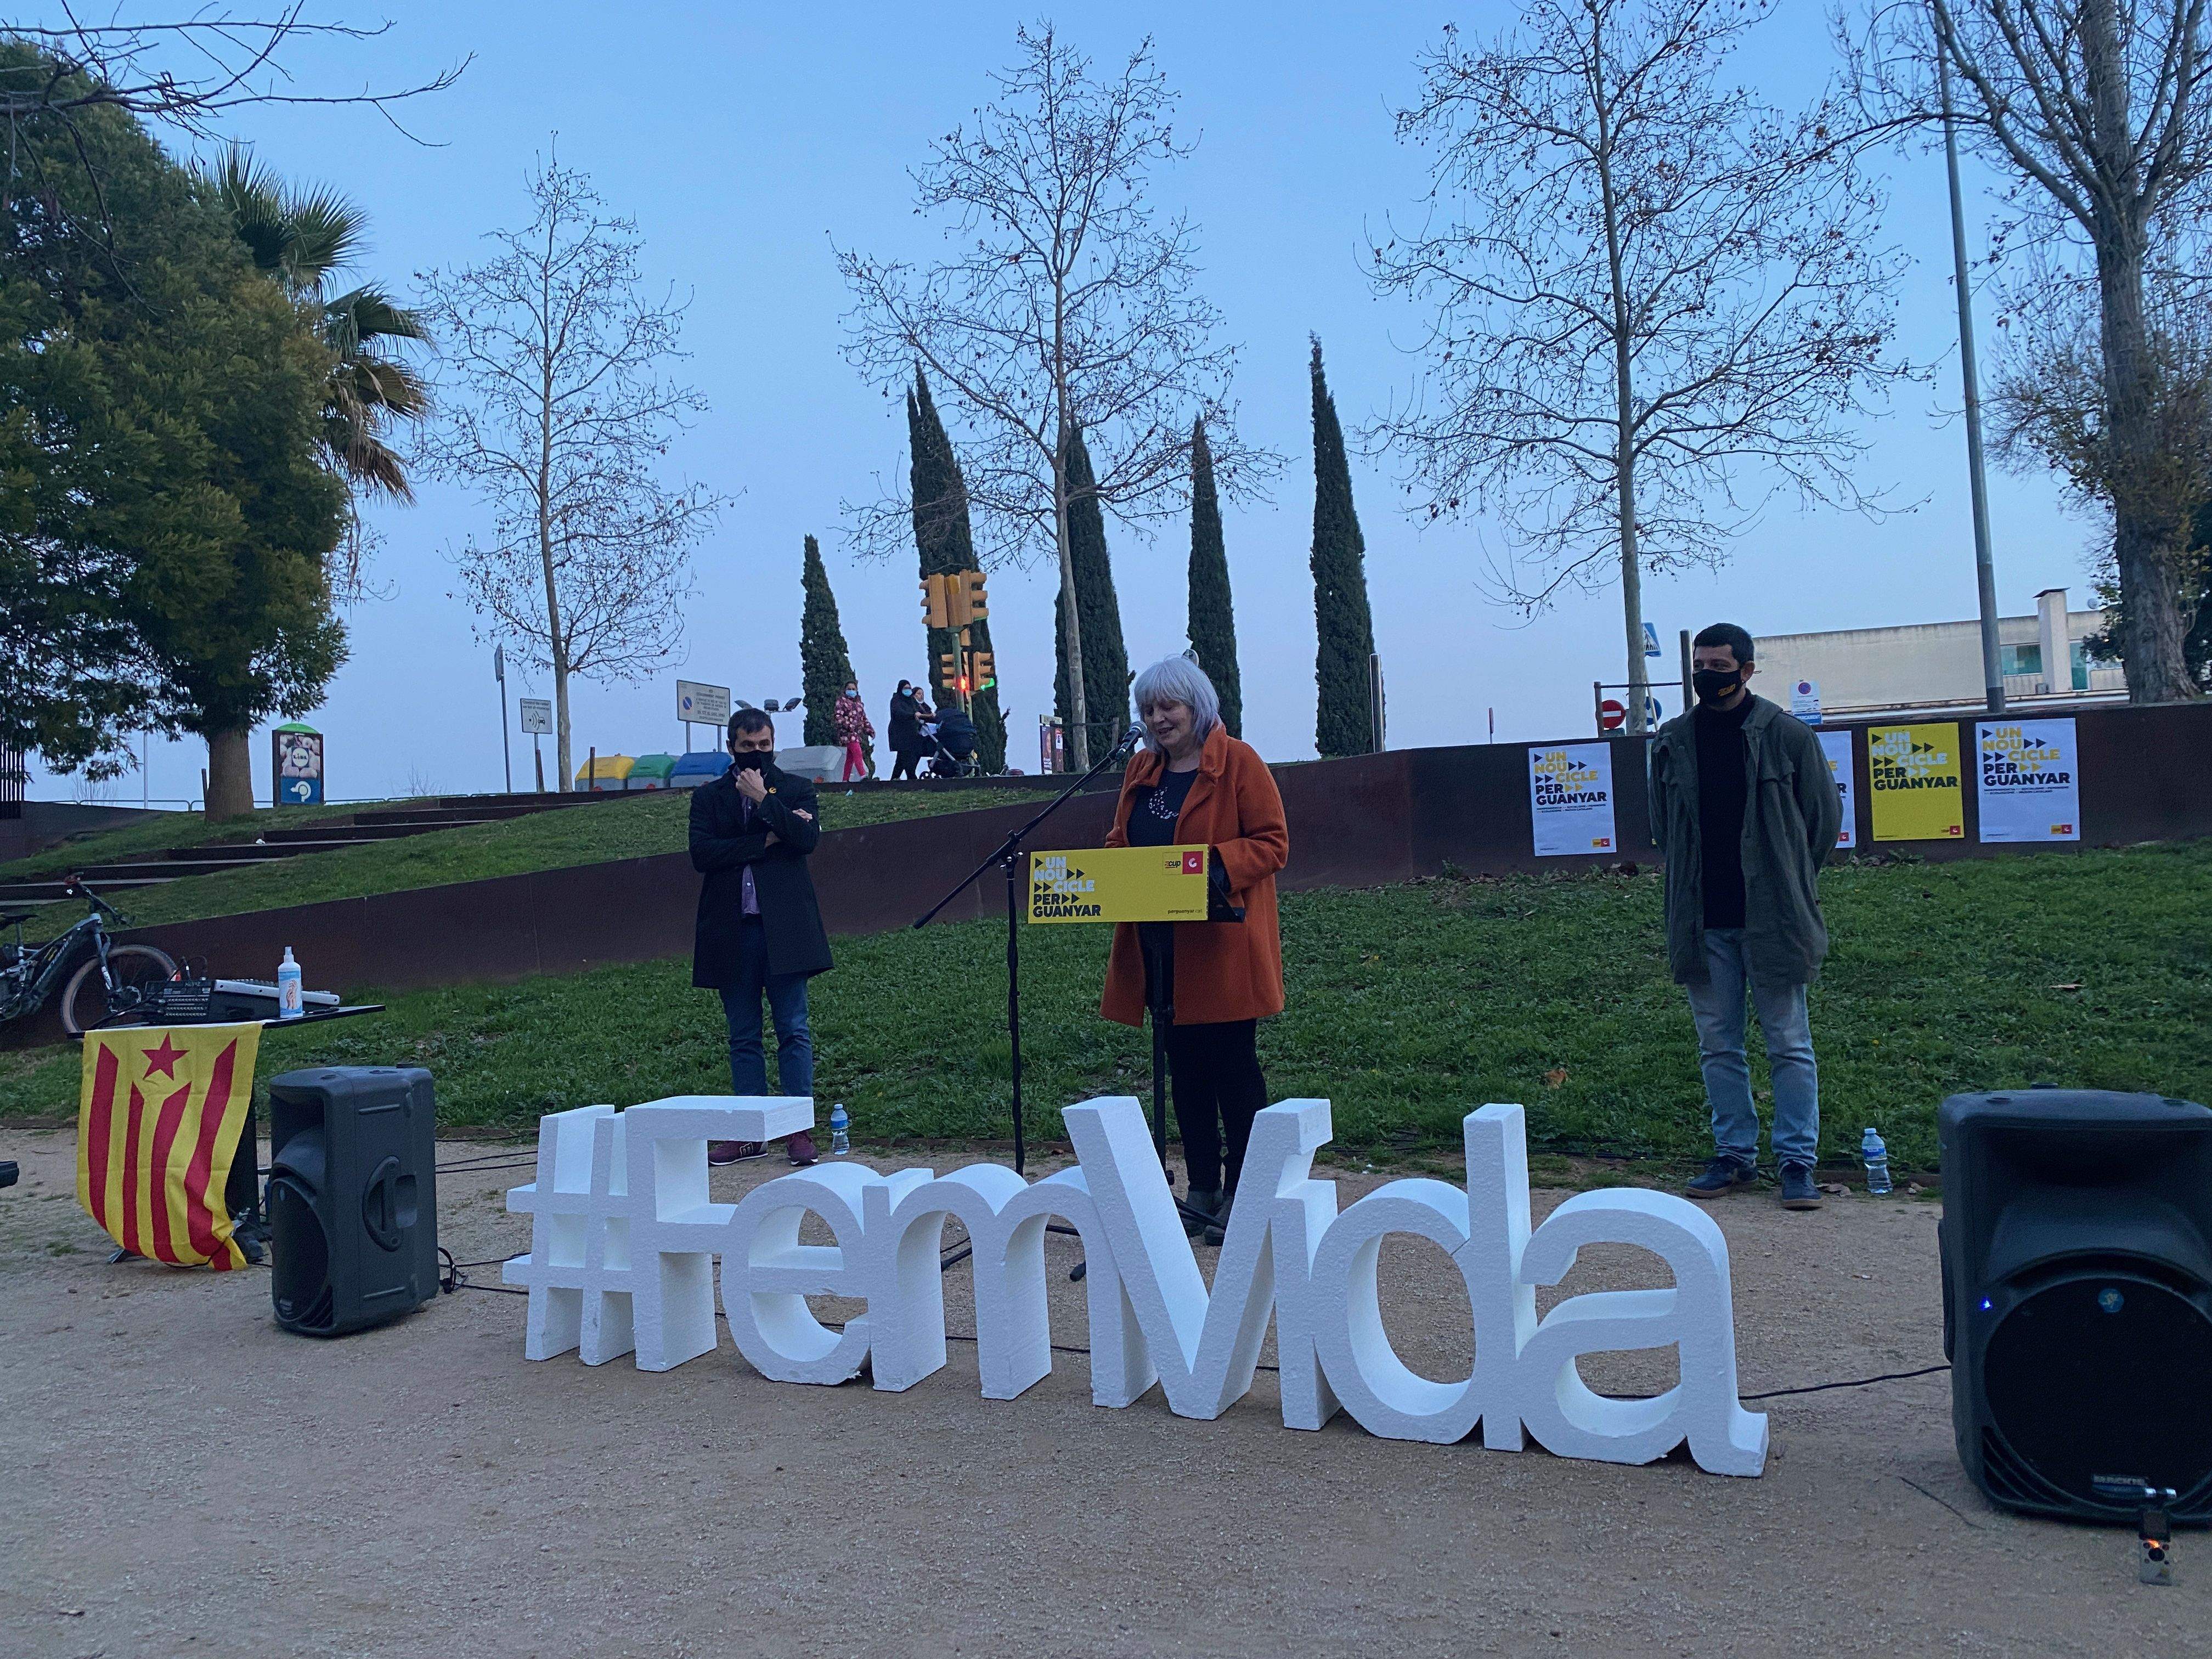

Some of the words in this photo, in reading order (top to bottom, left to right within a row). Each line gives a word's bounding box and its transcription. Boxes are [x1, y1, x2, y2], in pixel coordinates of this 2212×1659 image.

[1884, 731, 1910, 743] UN
[1996, 727, 2022, 738] UN
[1871, 743, 1911, 757] NOU
[1983, 738, 2022, 751] NOU
[1545, 751, 1567, 762] UN
[1896, 753, 1948, 766] CICLE
[2008, 748, 2060, 762] CICLE
[1534, 761, 1567, 774] NOU
[1874, 767, 1907, 779] PER
[1984, 763, 2017, 774] PER
[1555, 770, 1598, 783] CICLE
[1984, 772, 2070, 786] GUANYAR
[1536, 783, 1564, 794] PER
[1874, 776, 1958, 791] GUANYAR
[1537, 792, 1607, 805] GUANYAR
[1045, 856, 1066, 868] UN
[1034, 868, 1066, 881] NOU
[1053, 879, 1095, 893] CICLE
[1034, 893, 1060, 905] PER
[1033, 905, 1101, 917] GUANYAR
